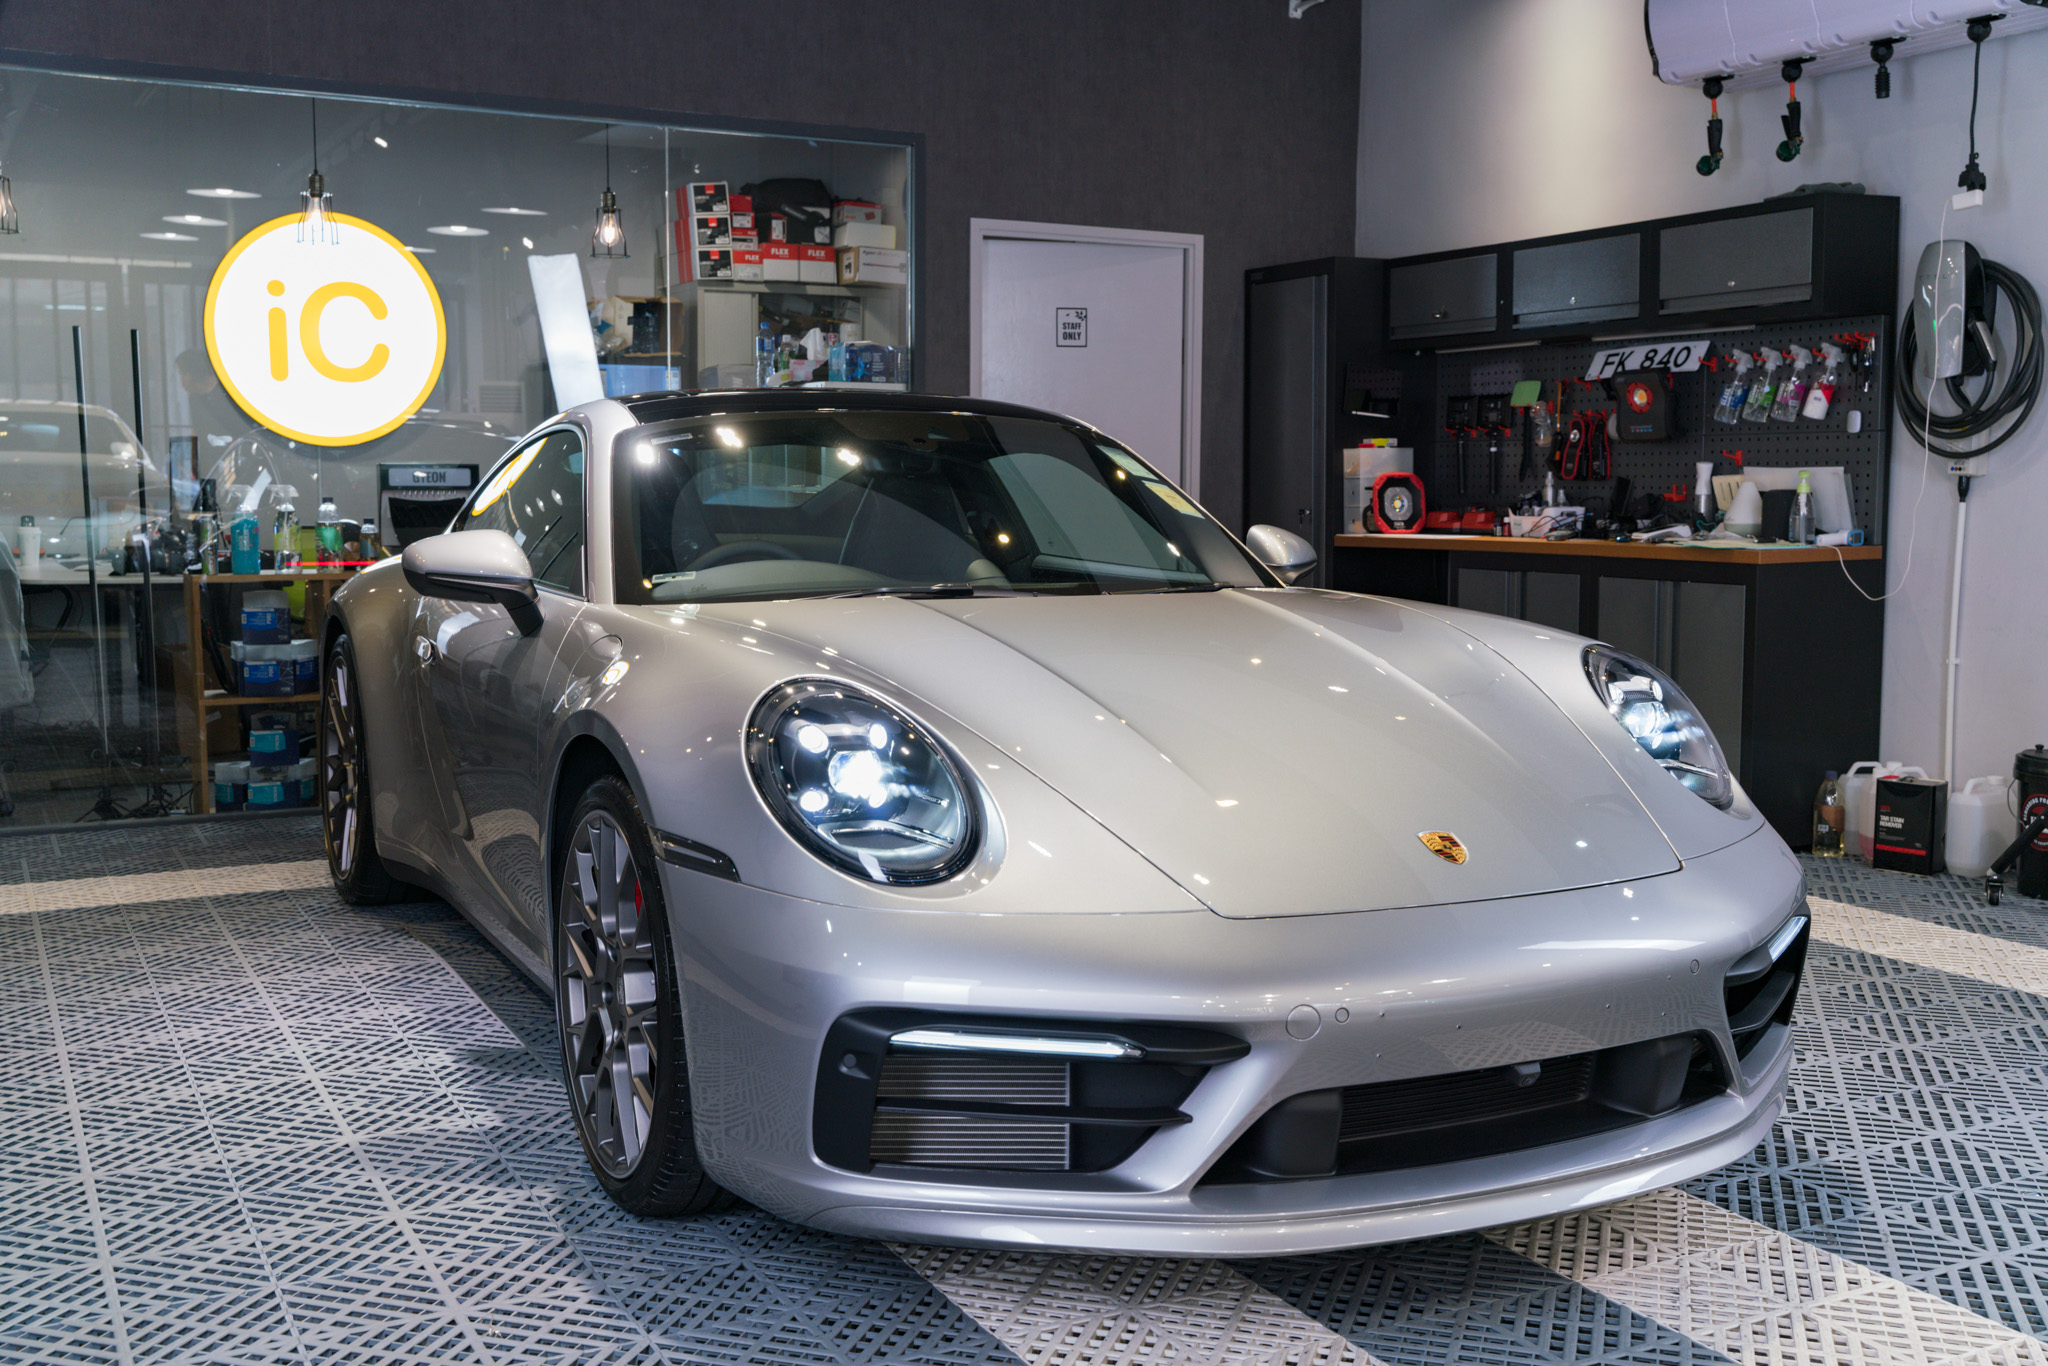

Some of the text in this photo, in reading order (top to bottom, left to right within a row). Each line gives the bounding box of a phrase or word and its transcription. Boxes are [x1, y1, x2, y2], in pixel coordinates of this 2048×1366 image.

[770, 247, 790, 255] FLEX
[808, 249, 826, 257] FLEX
[1062, 322, 1082, 330] STAFF
[1062, 331, 1082, 340] ONLY
[1600, 346, 1692, 375] FK 840
[1879, 820, 1903, 829] REMOVER
